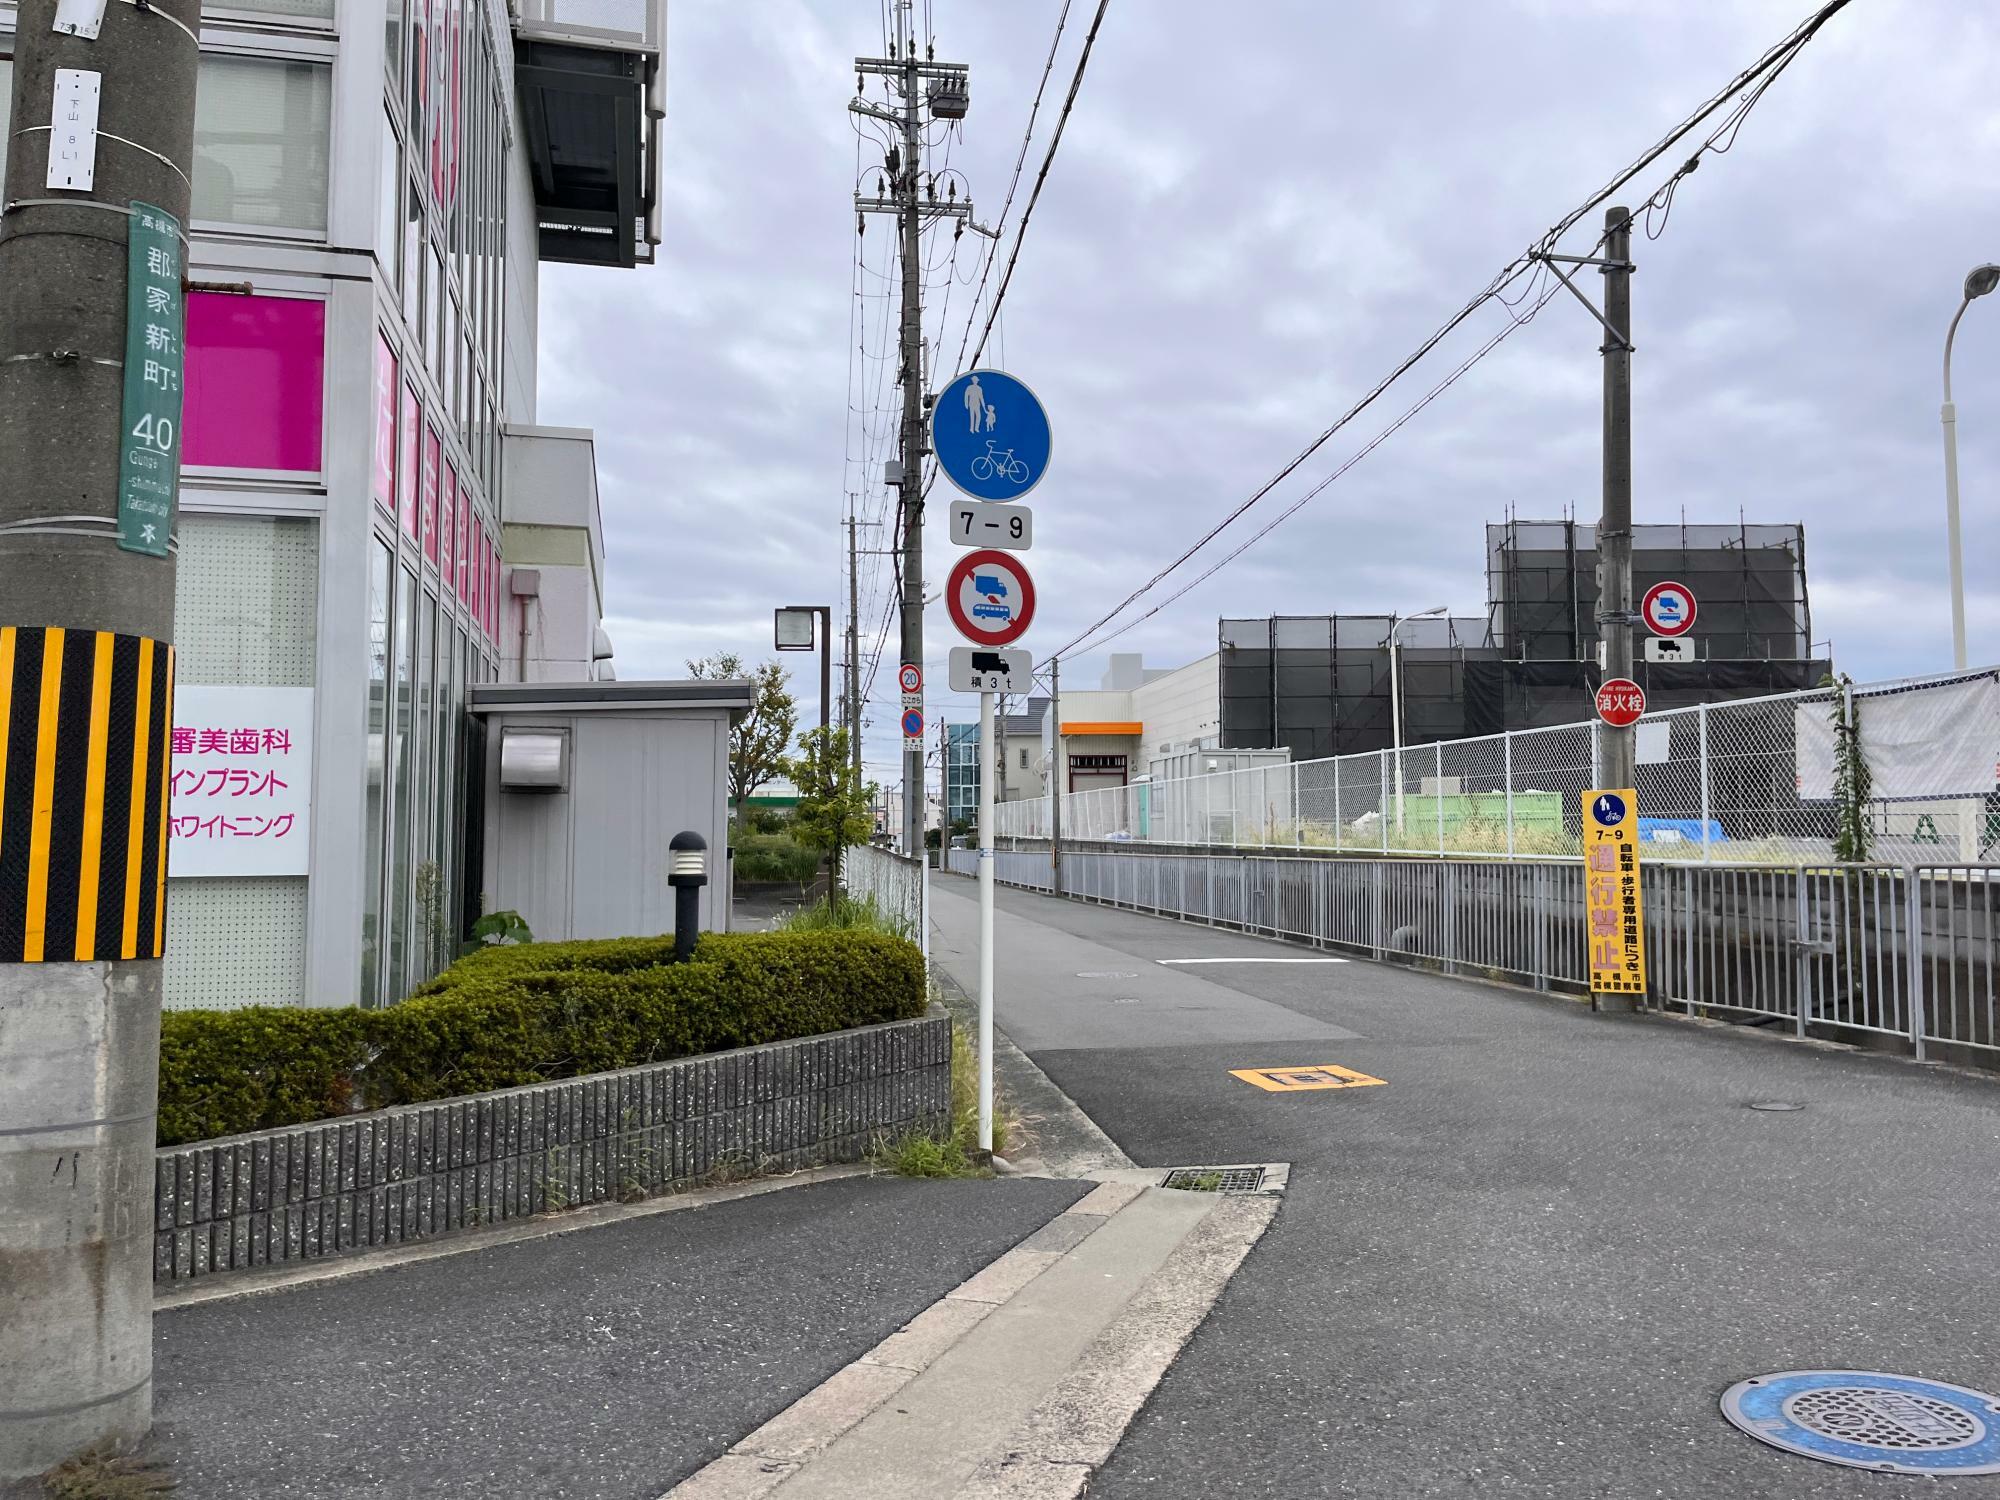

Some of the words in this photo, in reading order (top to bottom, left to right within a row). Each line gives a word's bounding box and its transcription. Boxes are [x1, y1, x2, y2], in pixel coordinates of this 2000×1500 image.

[68, 99, 80, 121] 下山
[68, 135, 76, 144] 8
[144, 246, 171, 391] 郡家新町
[132, 412, 173, 451] 40
[903, 672, 917, 686] 20
[1599, 694, 1642, 712] 消火栓
[172, 727, 292, 755] 審美歯科
[171, 768, 288, 797] インプラント
[1588, 843, 1620, 970] 通行禁止
